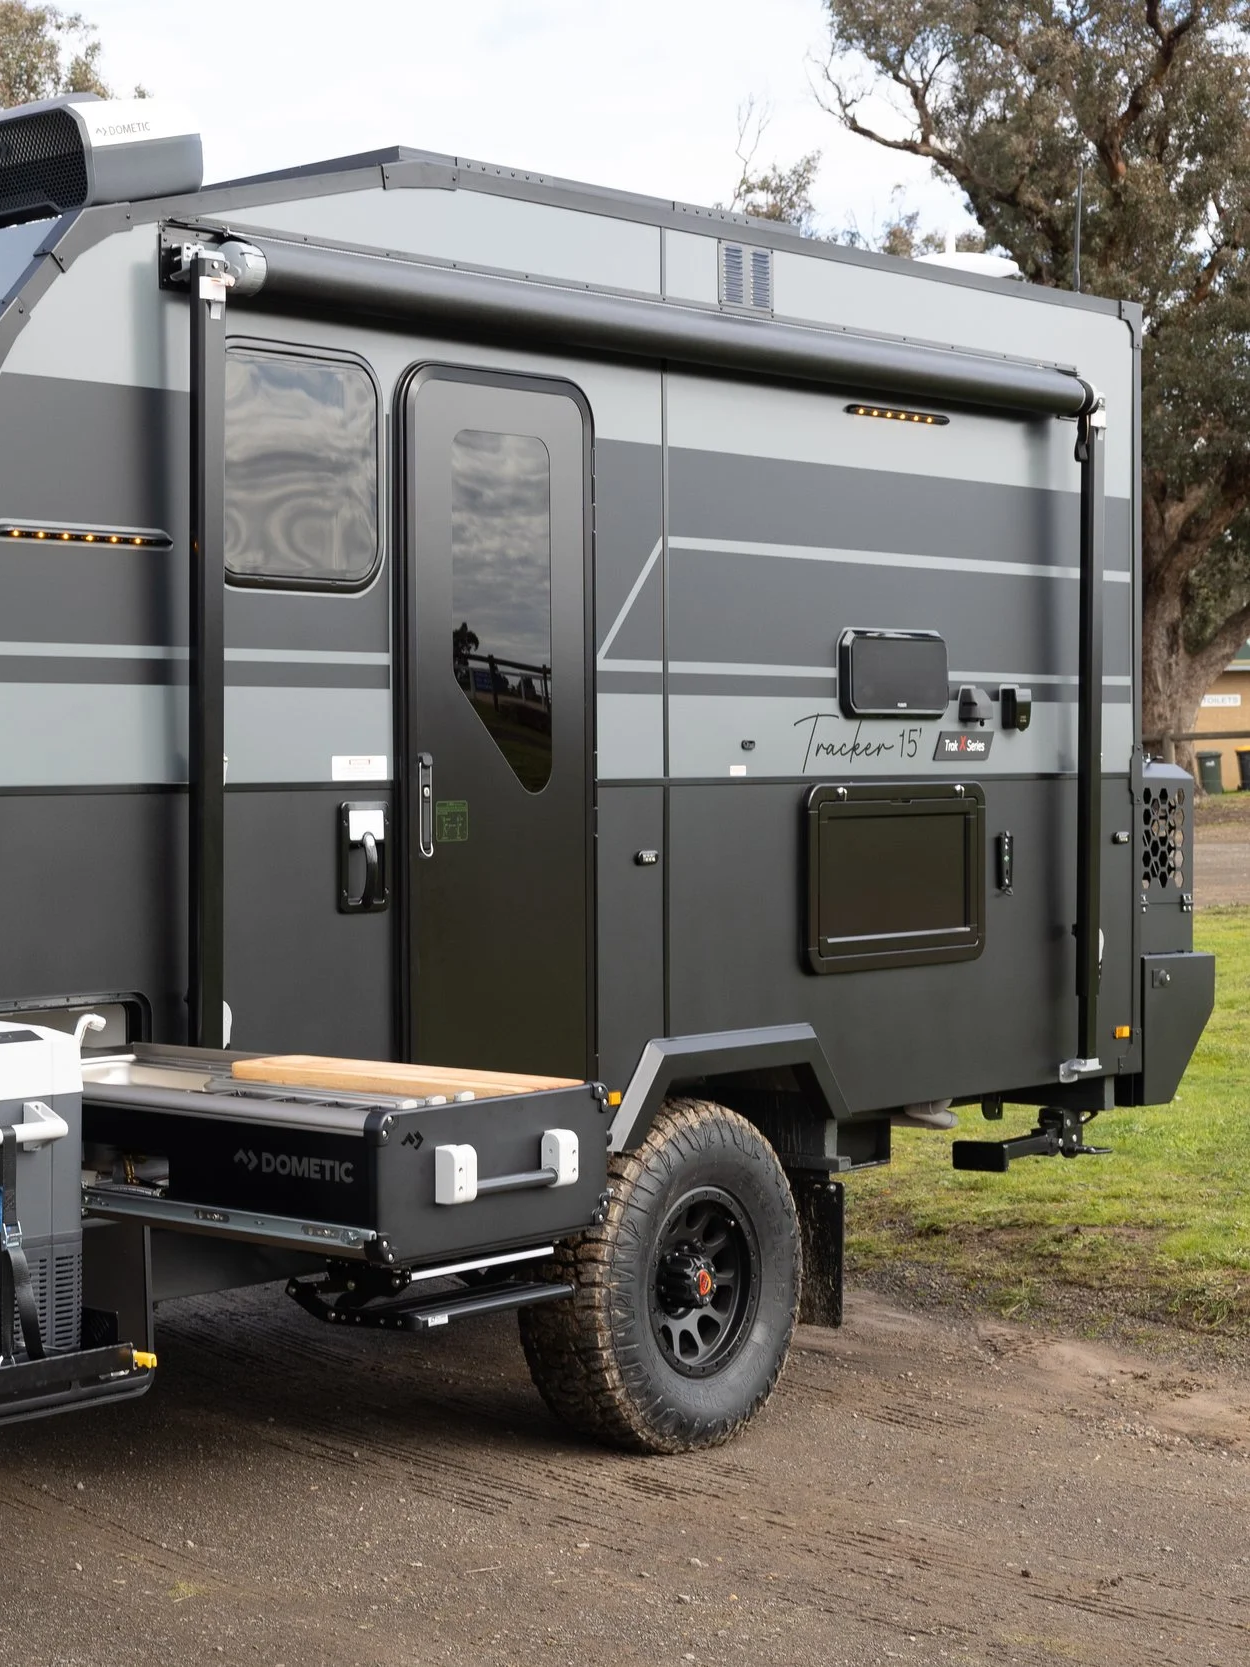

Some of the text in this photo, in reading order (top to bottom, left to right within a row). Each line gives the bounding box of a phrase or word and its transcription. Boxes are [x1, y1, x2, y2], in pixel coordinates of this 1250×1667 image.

[108, 121, 151, 136] DOMETIC
[1203, 696, 1239, 704] TOILETS
[793, 712, 895, 774] Tracker
[944, 735, 986, 752] Trak X Series
[261, 1151, 355, 1184] DOMETIC
